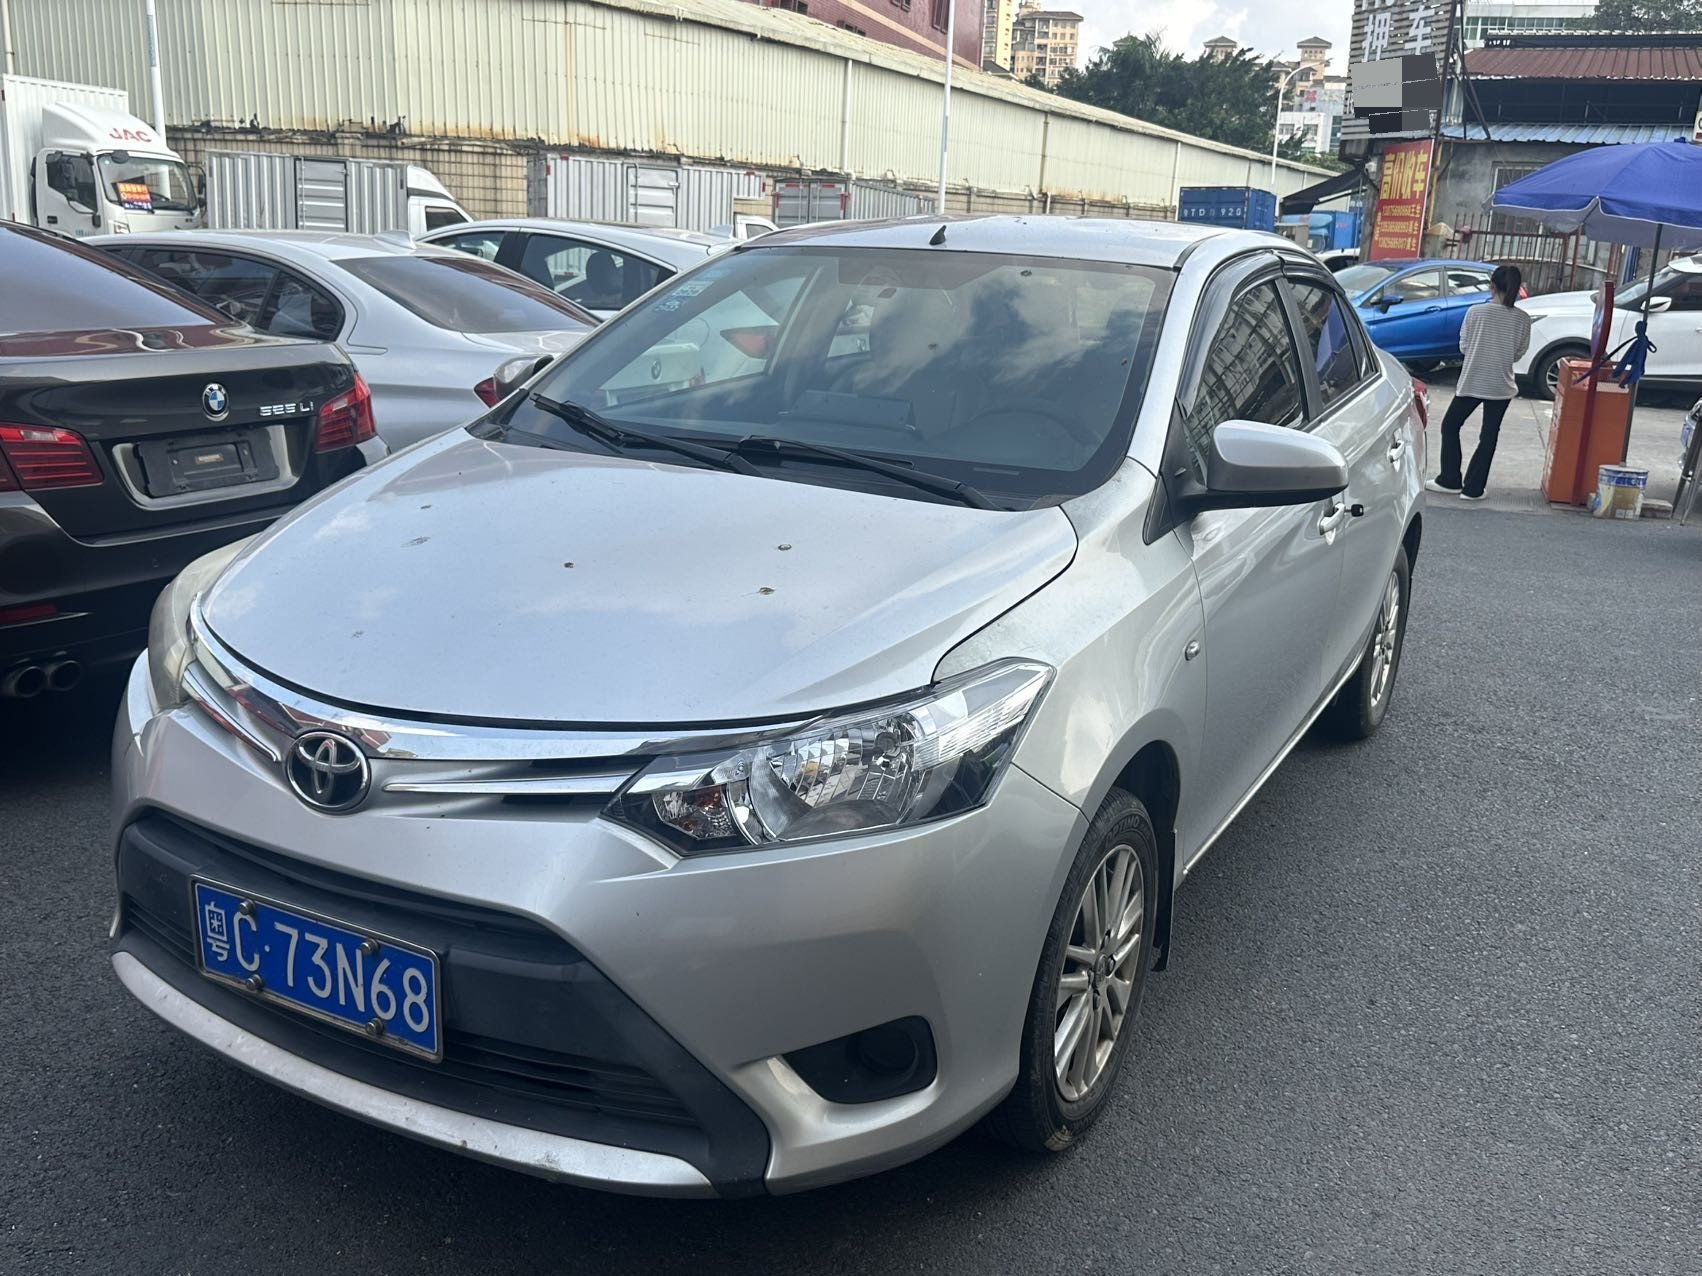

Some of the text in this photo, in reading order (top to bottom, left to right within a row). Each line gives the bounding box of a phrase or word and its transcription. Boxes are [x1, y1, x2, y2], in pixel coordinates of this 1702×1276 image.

[109, 128, 152, 143] JAC
[1380, 149, 1429, 200] 高价收车
[1221, 206, 1242, 217] 920
[260, 403, 297, 416] 525
